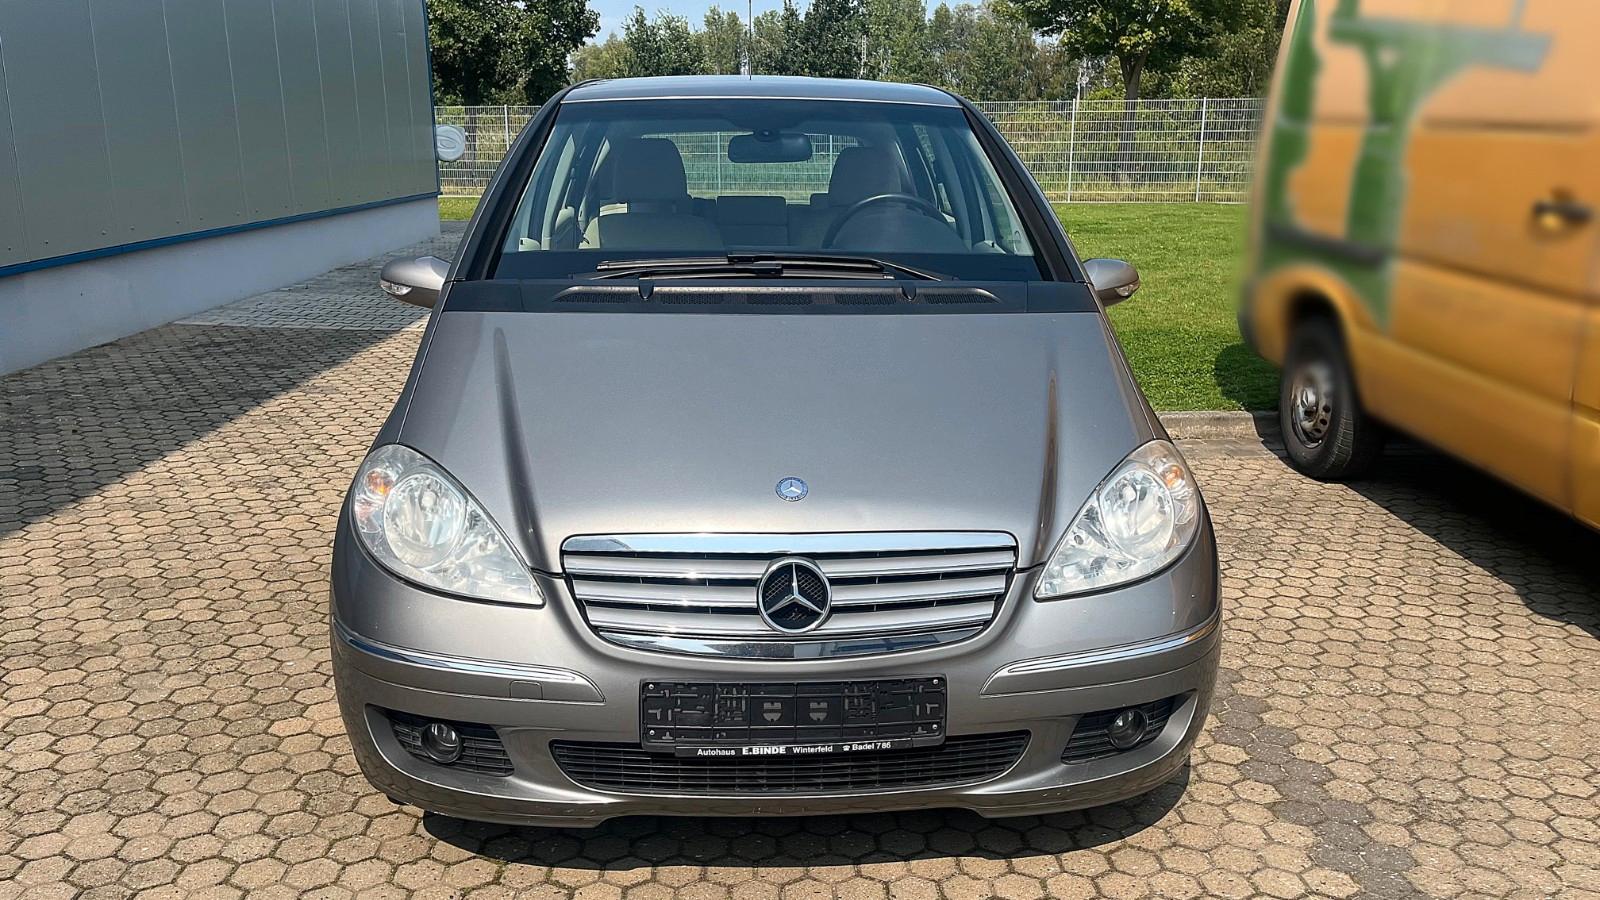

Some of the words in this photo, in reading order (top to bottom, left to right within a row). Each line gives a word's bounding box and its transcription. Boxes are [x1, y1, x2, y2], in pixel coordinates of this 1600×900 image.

[697, 748, 736, 756] Autohaus
[742, 746, 786, 755] E.BINDE
[792, 745, 833, 754] Winterfeld
[852, 743, 875, 751] Badel
